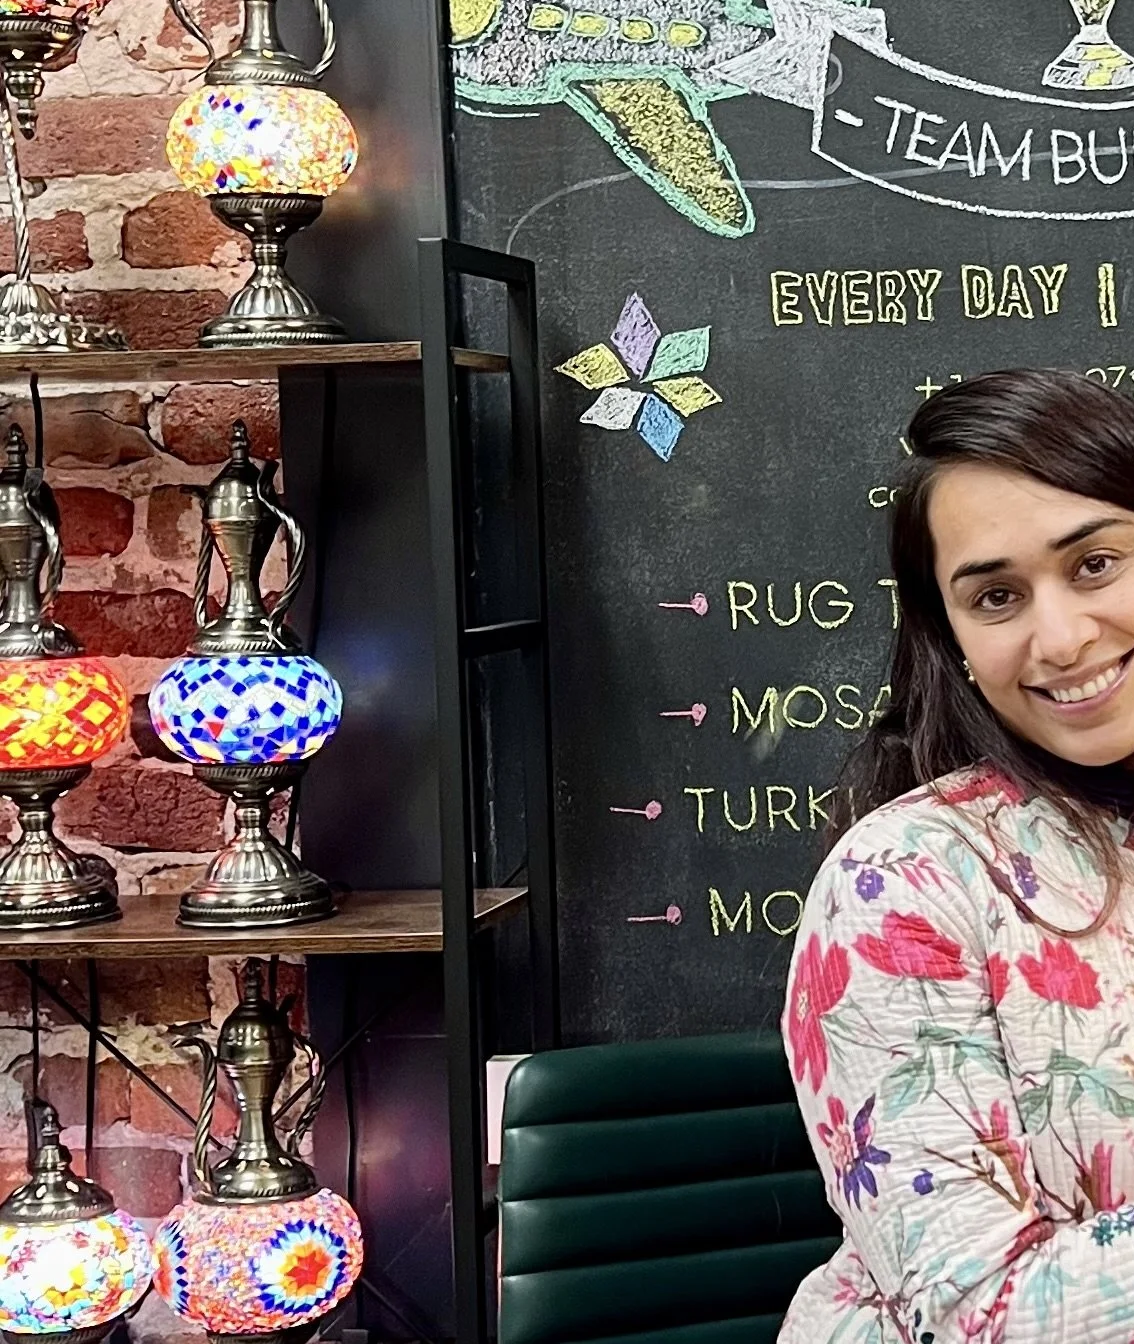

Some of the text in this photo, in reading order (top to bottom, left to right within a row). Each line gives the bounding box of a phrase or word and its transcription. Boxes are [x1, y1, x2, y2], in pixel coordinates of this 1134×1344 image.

[875, 95, 1032, 182] TEAM
[771, 269, 943, 327] EVERY
[960, 263, 1068, 320] DAY
[727, 580, 855, 631] RUG
[732, 684, 893, 735] MOSA
[709, 887, 803, 937] MO
